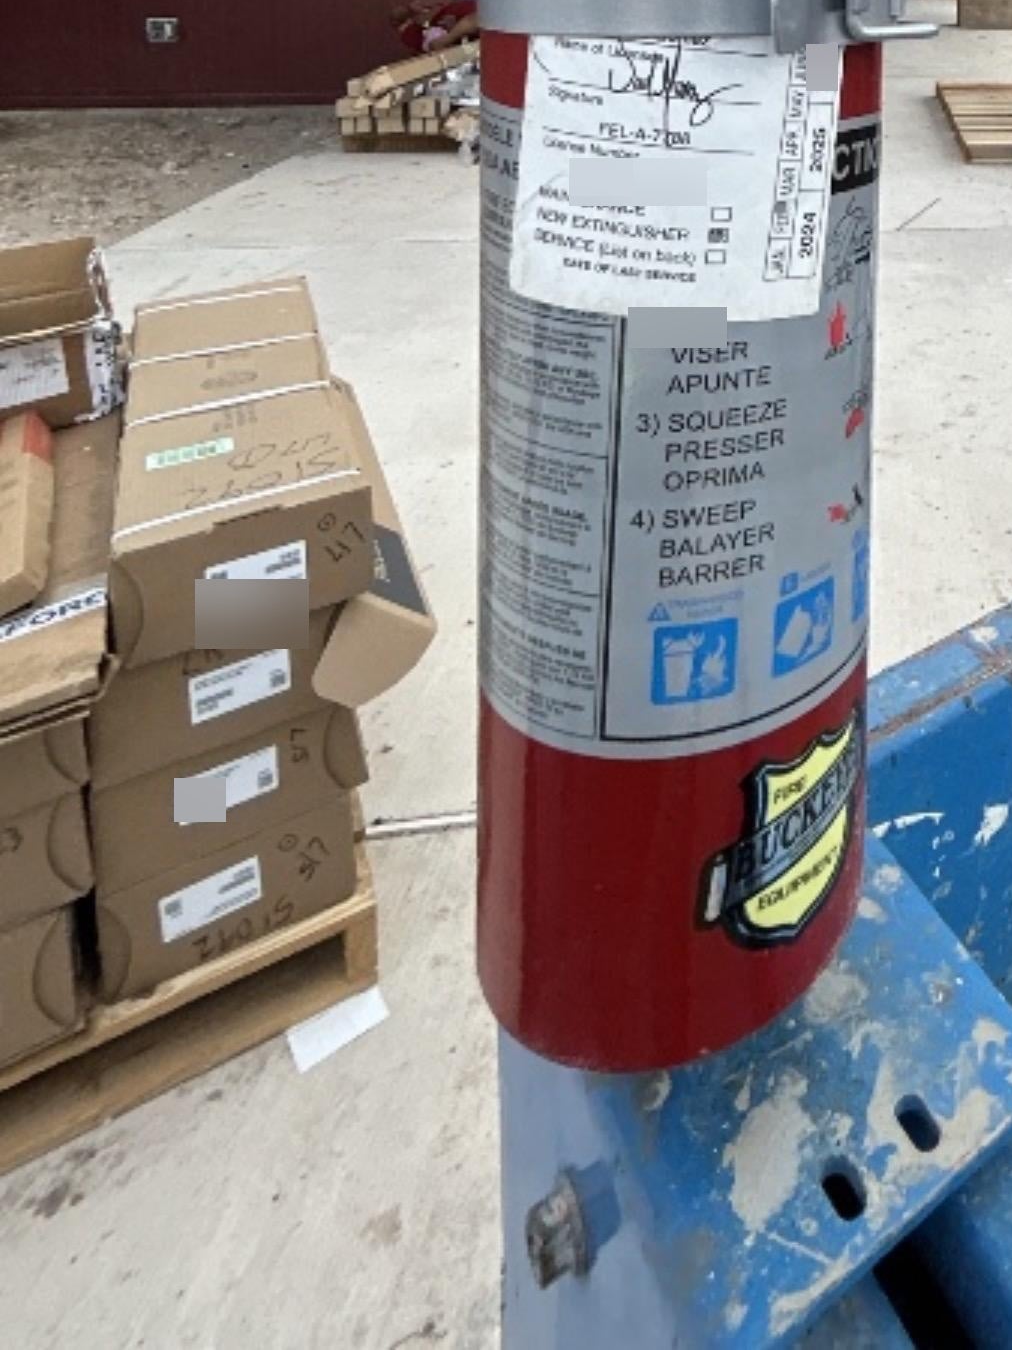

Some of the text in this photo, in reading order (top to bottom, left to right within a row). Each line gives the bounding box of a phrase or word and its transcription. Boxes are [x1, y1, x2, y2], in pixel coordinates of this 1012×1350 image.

[666, 365, 771, 396] APUNTE
[635, 398, 787, 438] 3) SQUEEZE
[664, 427, 784, 463] PRESSER
[663, 461, 765, 492] OPRIMA
[630, 498, 757, 534] 4) SWEEP
[659, 521, 775, 559] BALAYER
[659, 553, 765, 588] BARRER
